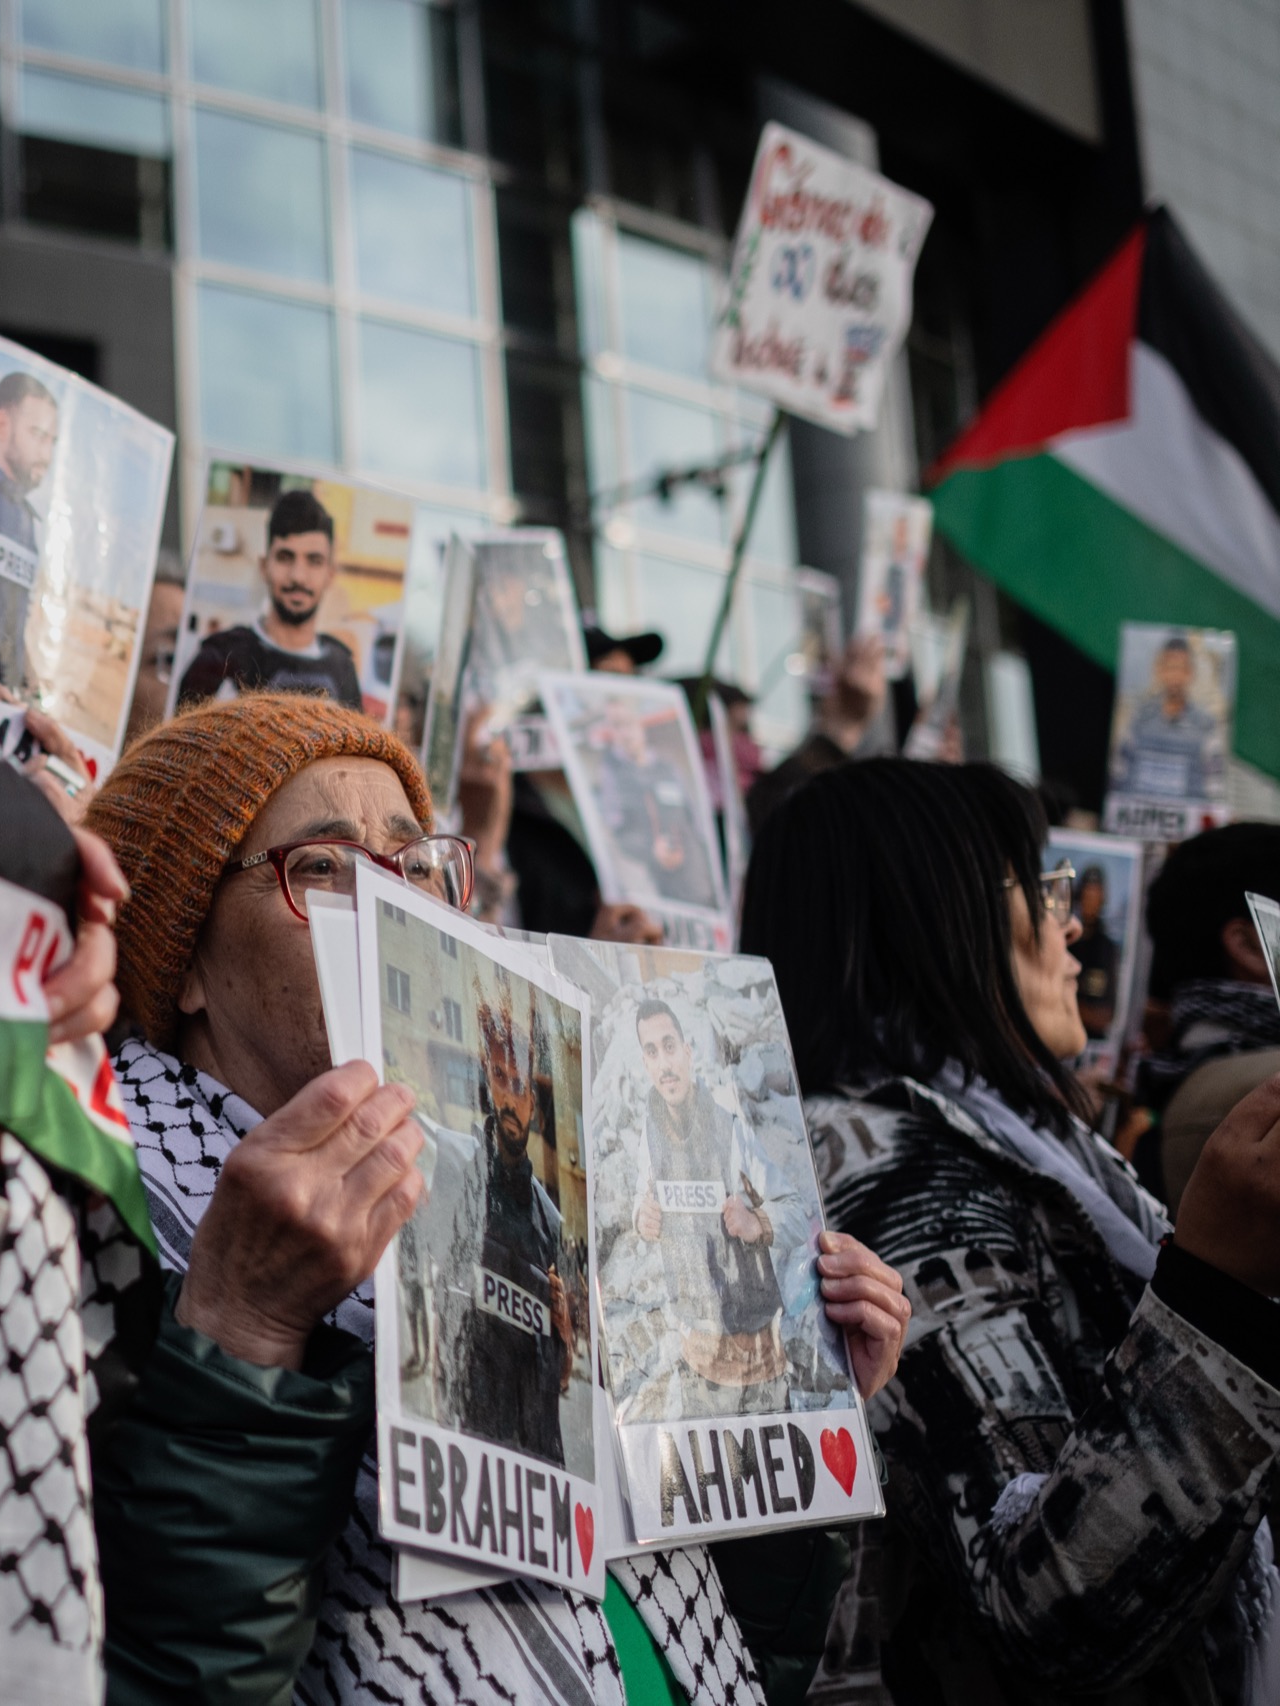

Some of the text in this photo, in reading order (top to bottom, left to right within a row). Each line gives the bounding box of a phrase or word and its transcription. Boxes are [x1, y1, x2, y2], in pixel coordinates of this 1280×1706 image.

[663, 1185, 718, 1208] PRESS
[483, 1273, 544, 1334] PRESS
[388, 1426, 574, 1579] EBRAHEM
[660, 1422, 816, 1527] AHMED
